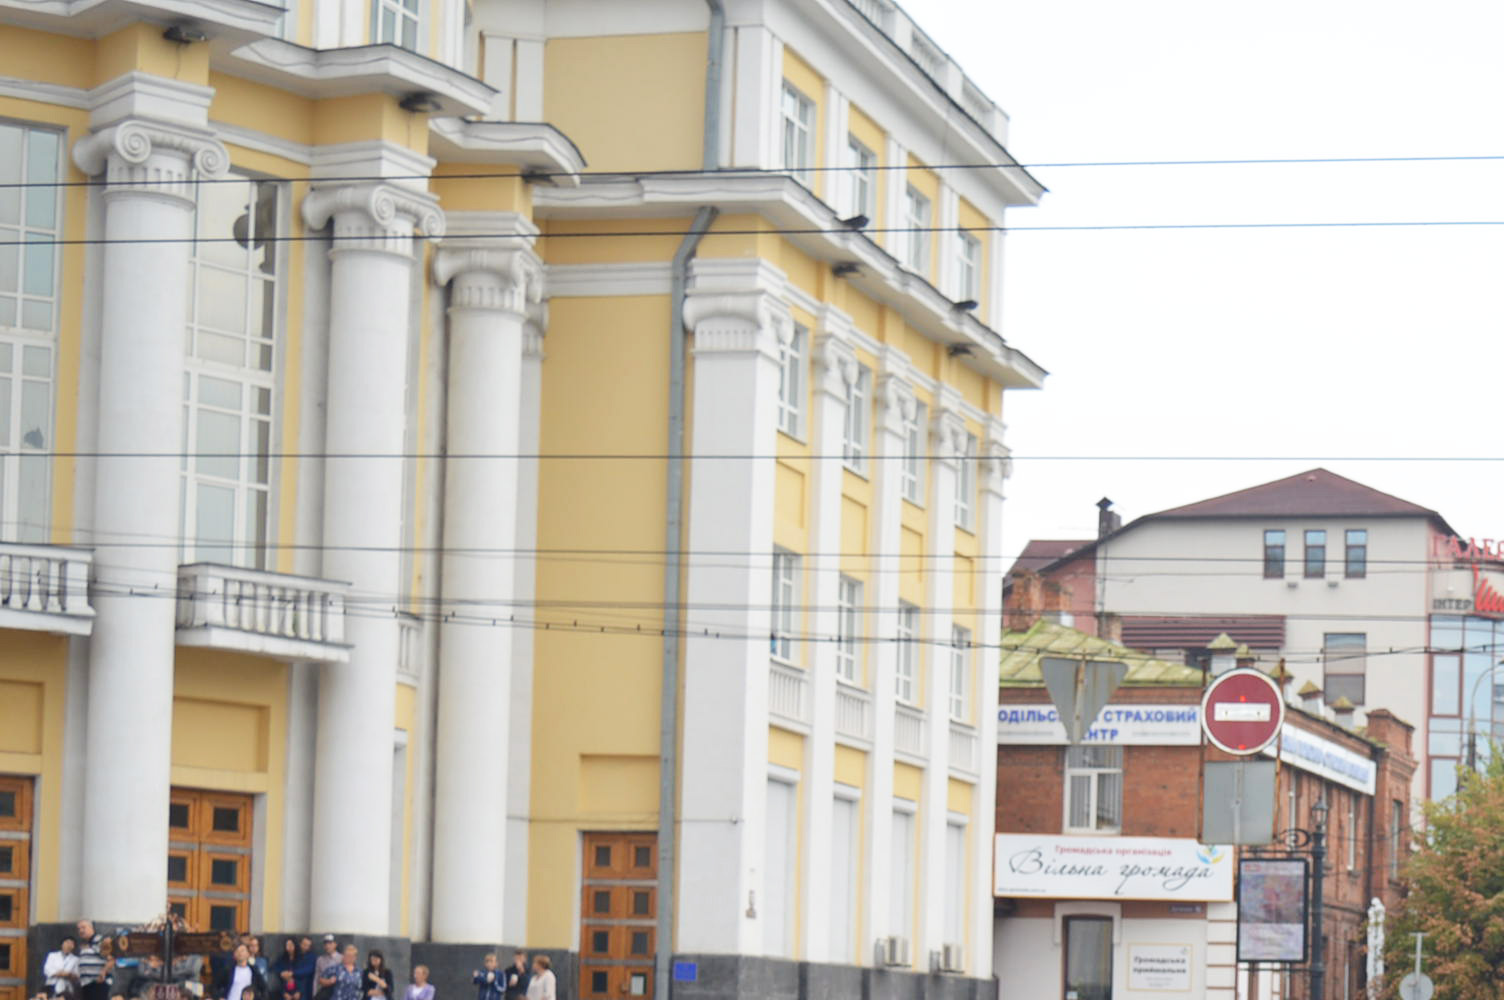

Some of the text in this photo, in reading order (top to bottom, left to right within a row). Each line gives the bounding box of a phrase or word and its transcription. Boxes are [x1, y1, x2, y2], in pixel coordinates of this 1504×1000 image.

[1103, 707, 1197, 723] СТРАХОВИЙ
[1009, 846, 1215, 896] Вільна громада
